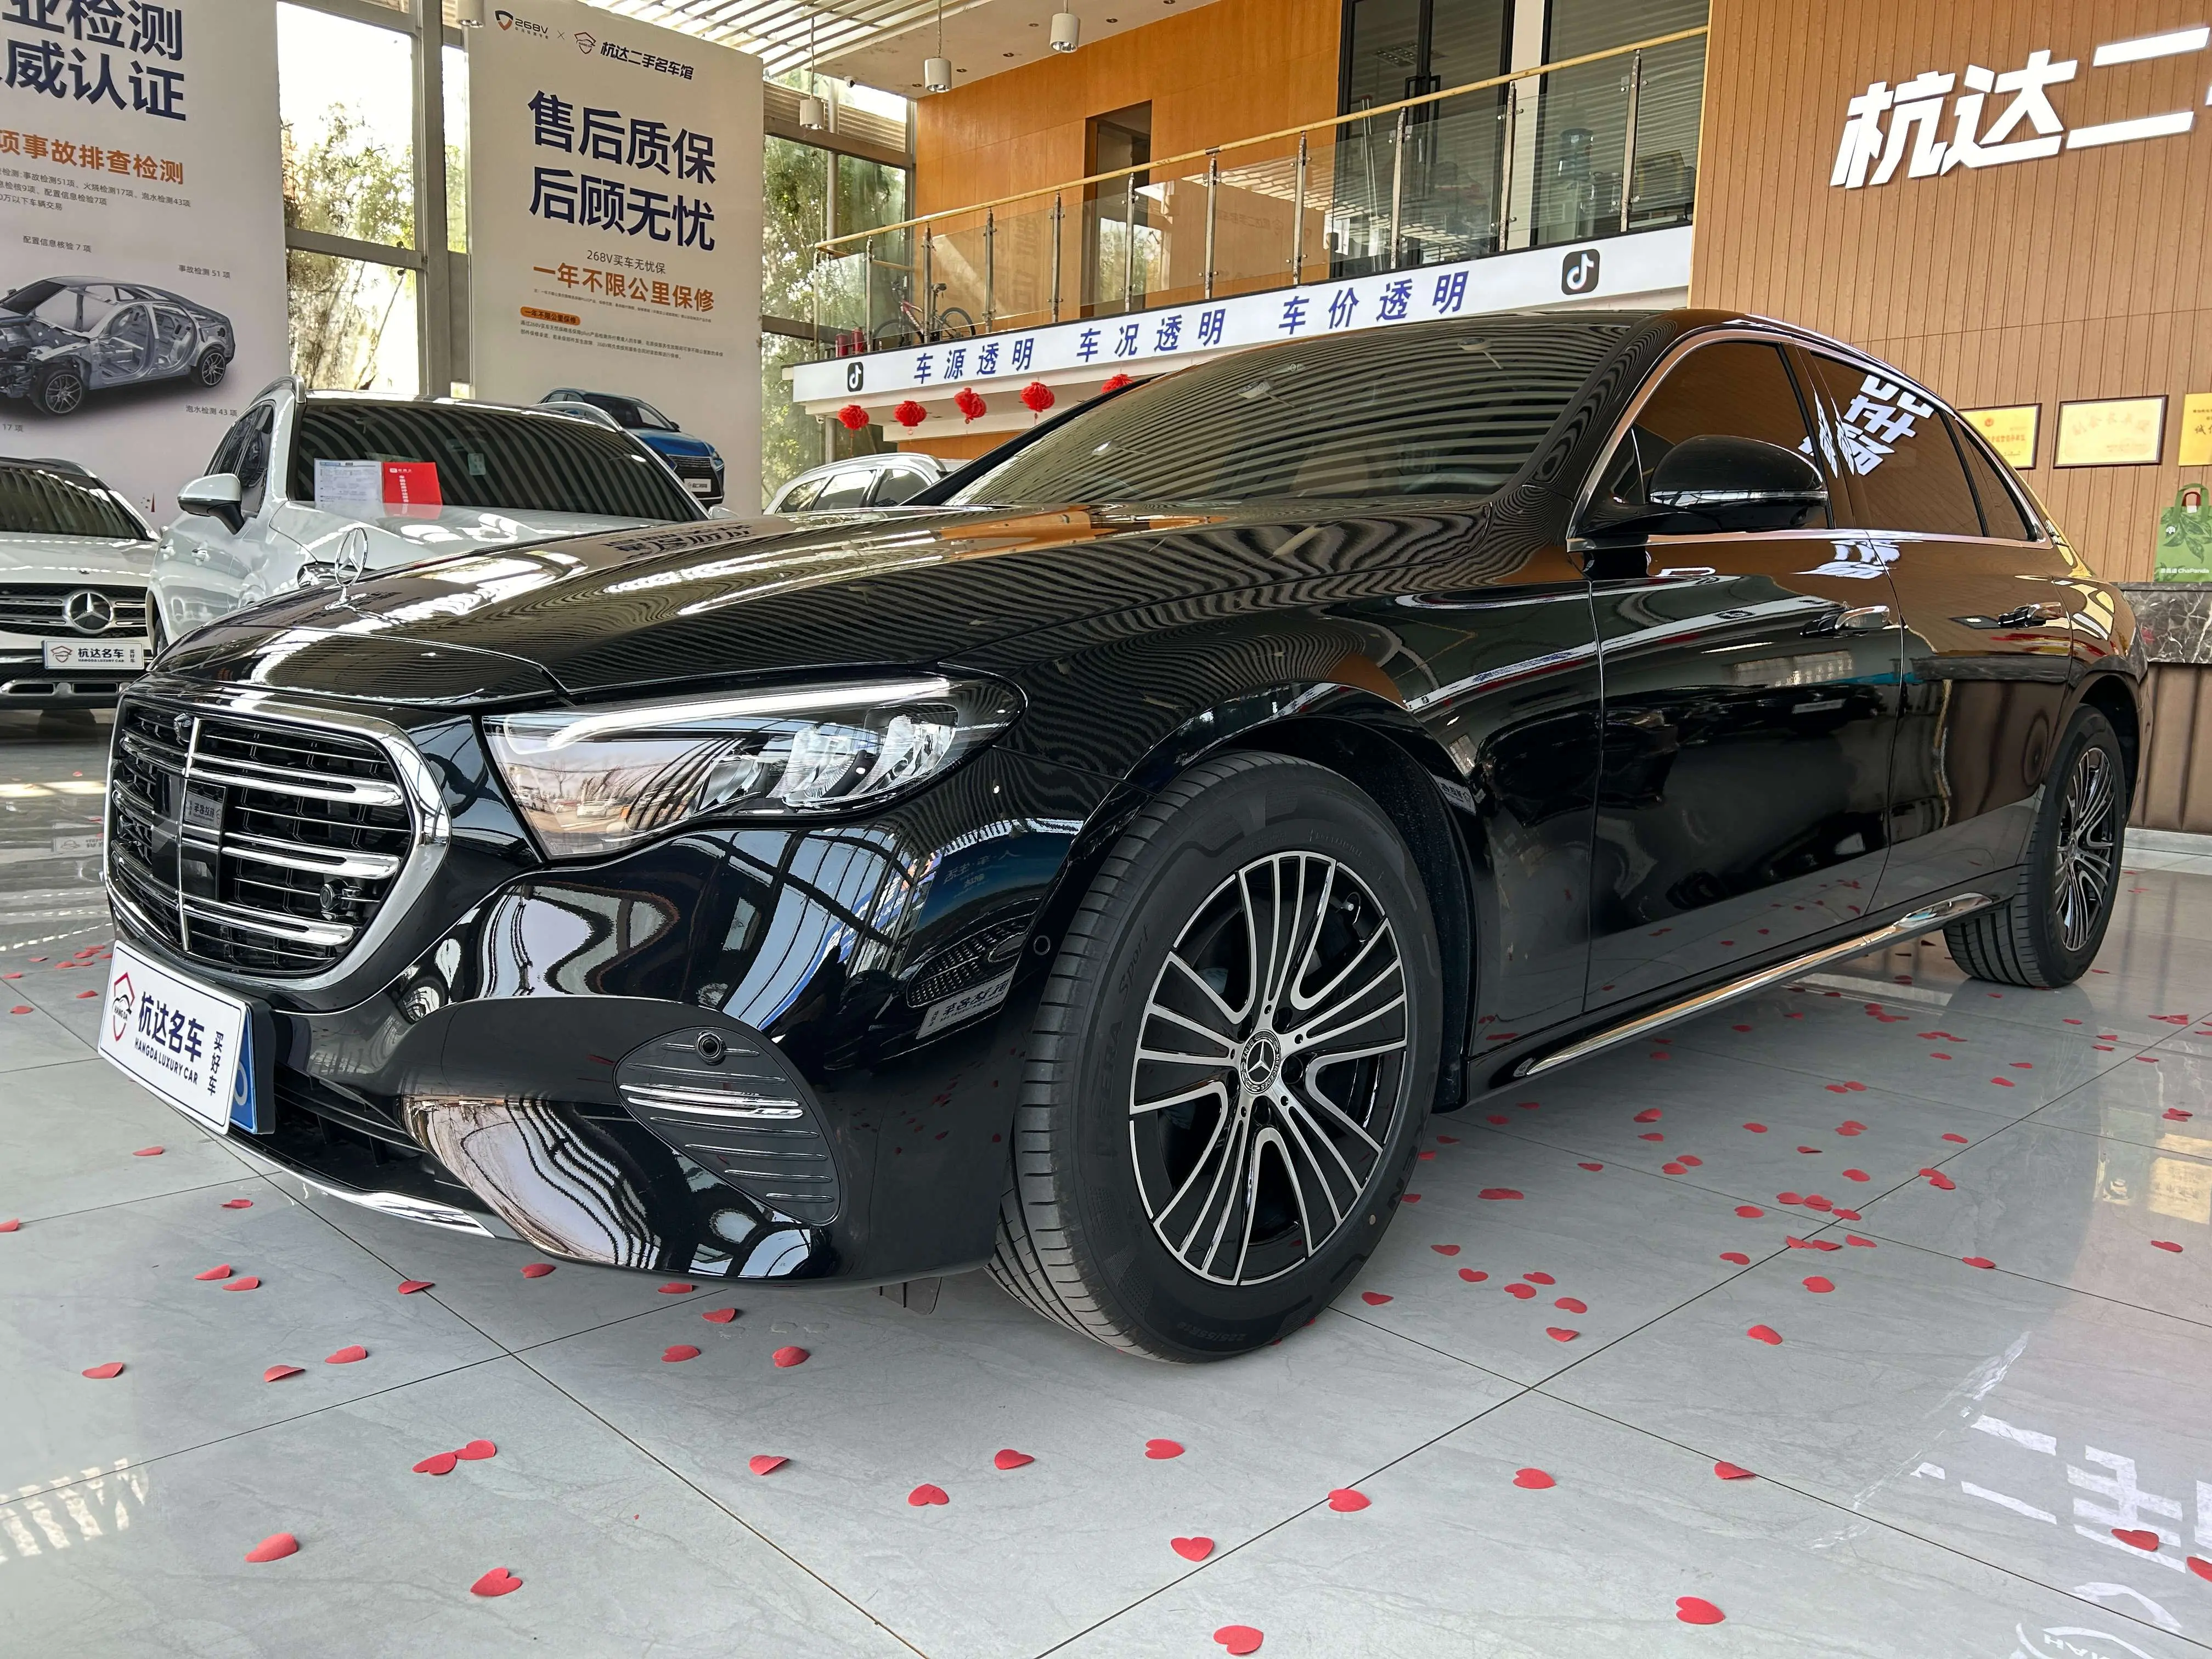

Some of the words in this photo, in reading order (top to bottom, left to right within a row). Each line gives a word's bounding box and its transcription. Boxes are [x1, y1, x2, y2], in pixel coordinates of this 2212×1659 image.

[2, 0, 182, 60] 业检测
[515, 18, 548, 33] 268V
[0, 39, 186, 121] 威认证
[600, 41, 693, 80] 杭达二手名车馆
[528, 90, 716, 184] 售后质保
[1830, 26, 2212, 189] 杭达二
[0, 129, 183, 185] 项事故排查检测
[529, 166, 715, 251] 后顾无忧
[533, 263, 714, 312] 一年不限公里保修
[587, 250, 666, 274] 268V买车无忧保
[914, 337, 1034, 384] 车源透明
[1076, 308, 1226, 363] 车况透明
[1279, 271, 1469, 335] 车价透明
[78, 648, 125, 658] 杭达名车
[1118, 924, 1149, 1003] Sport
[138, 991, 205, 1063] 杭达名车
[1242, 1039, 1255, 1060] BENZ
[134, 1037, 157, 1062] HANGDA
[157, 1052, 183, 1076] LUXURY
[183, 1066, 199, 1085] CAR
[207, 1030, 224, 1097] 买好车
